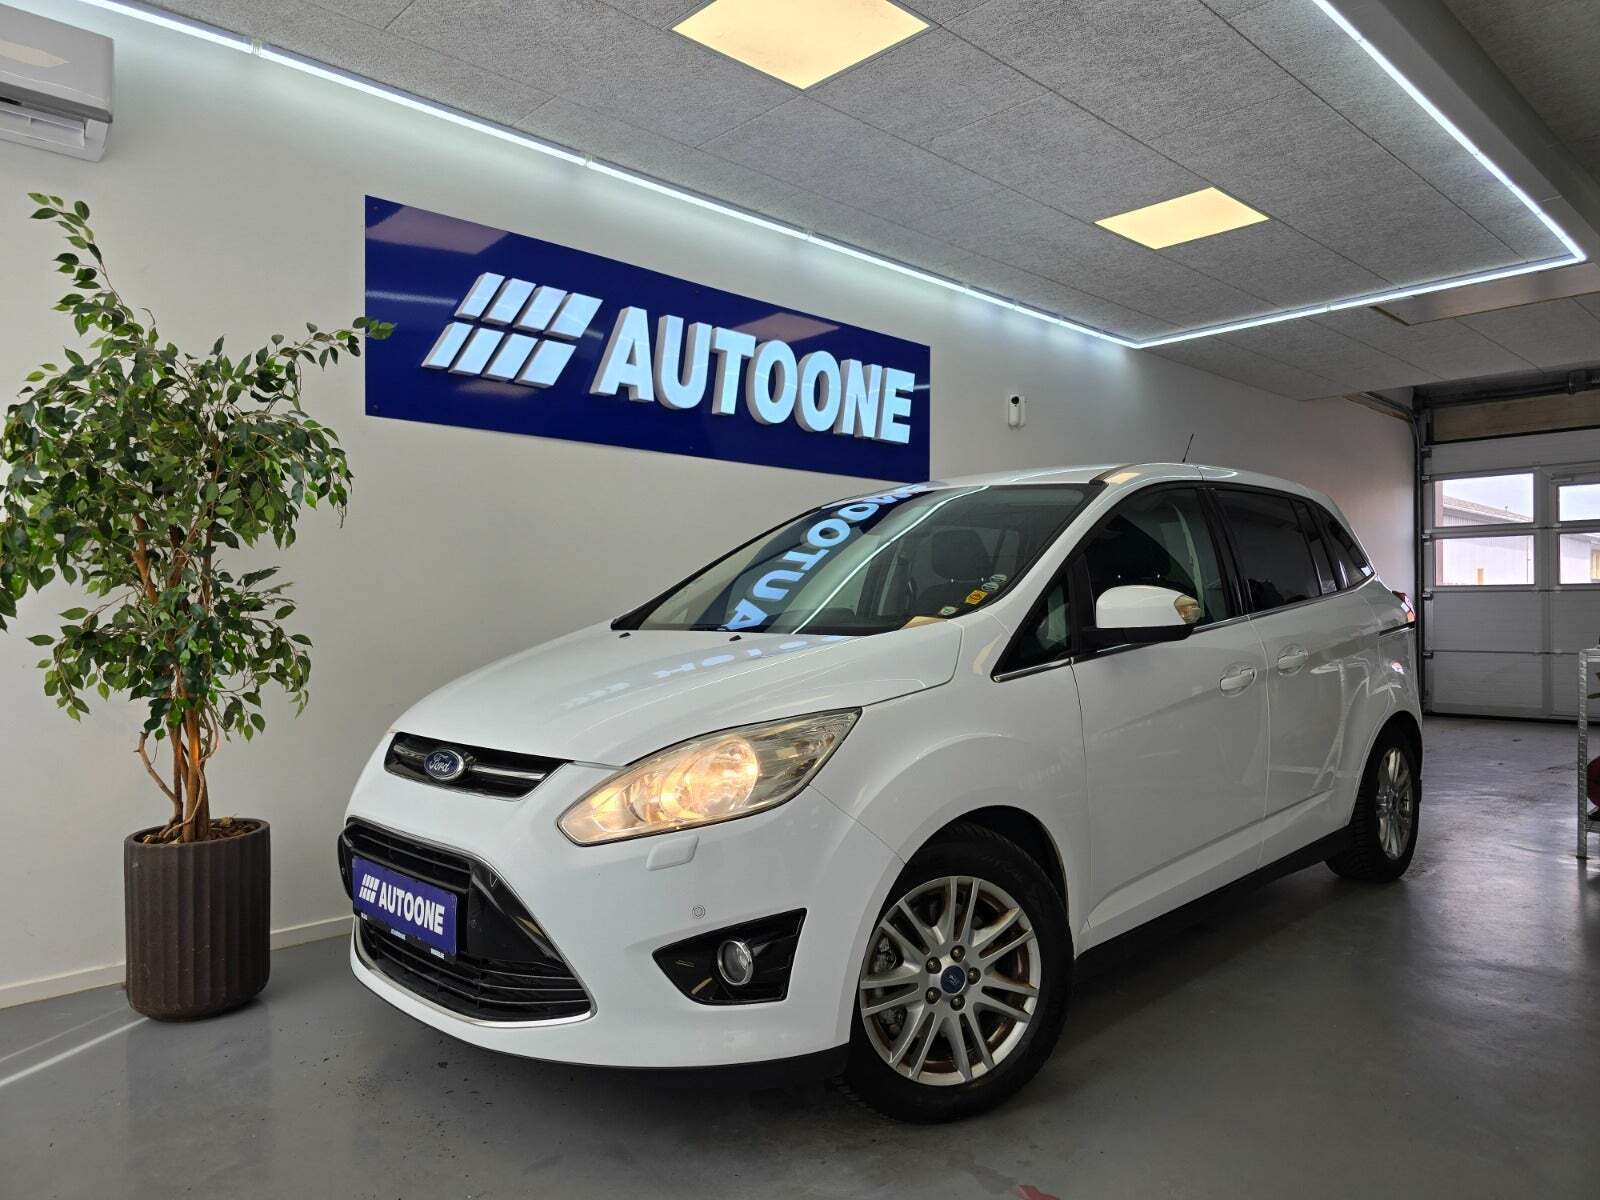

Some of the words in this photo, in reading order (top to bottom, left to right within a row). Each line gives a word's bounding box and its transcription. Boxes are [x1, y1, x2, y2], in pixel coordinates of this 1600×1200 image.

[590, 306, 915, 443] AUTOONE
[429, 753, 453, 772] Ford
[378, 881, 445, 935] AUTOONE
